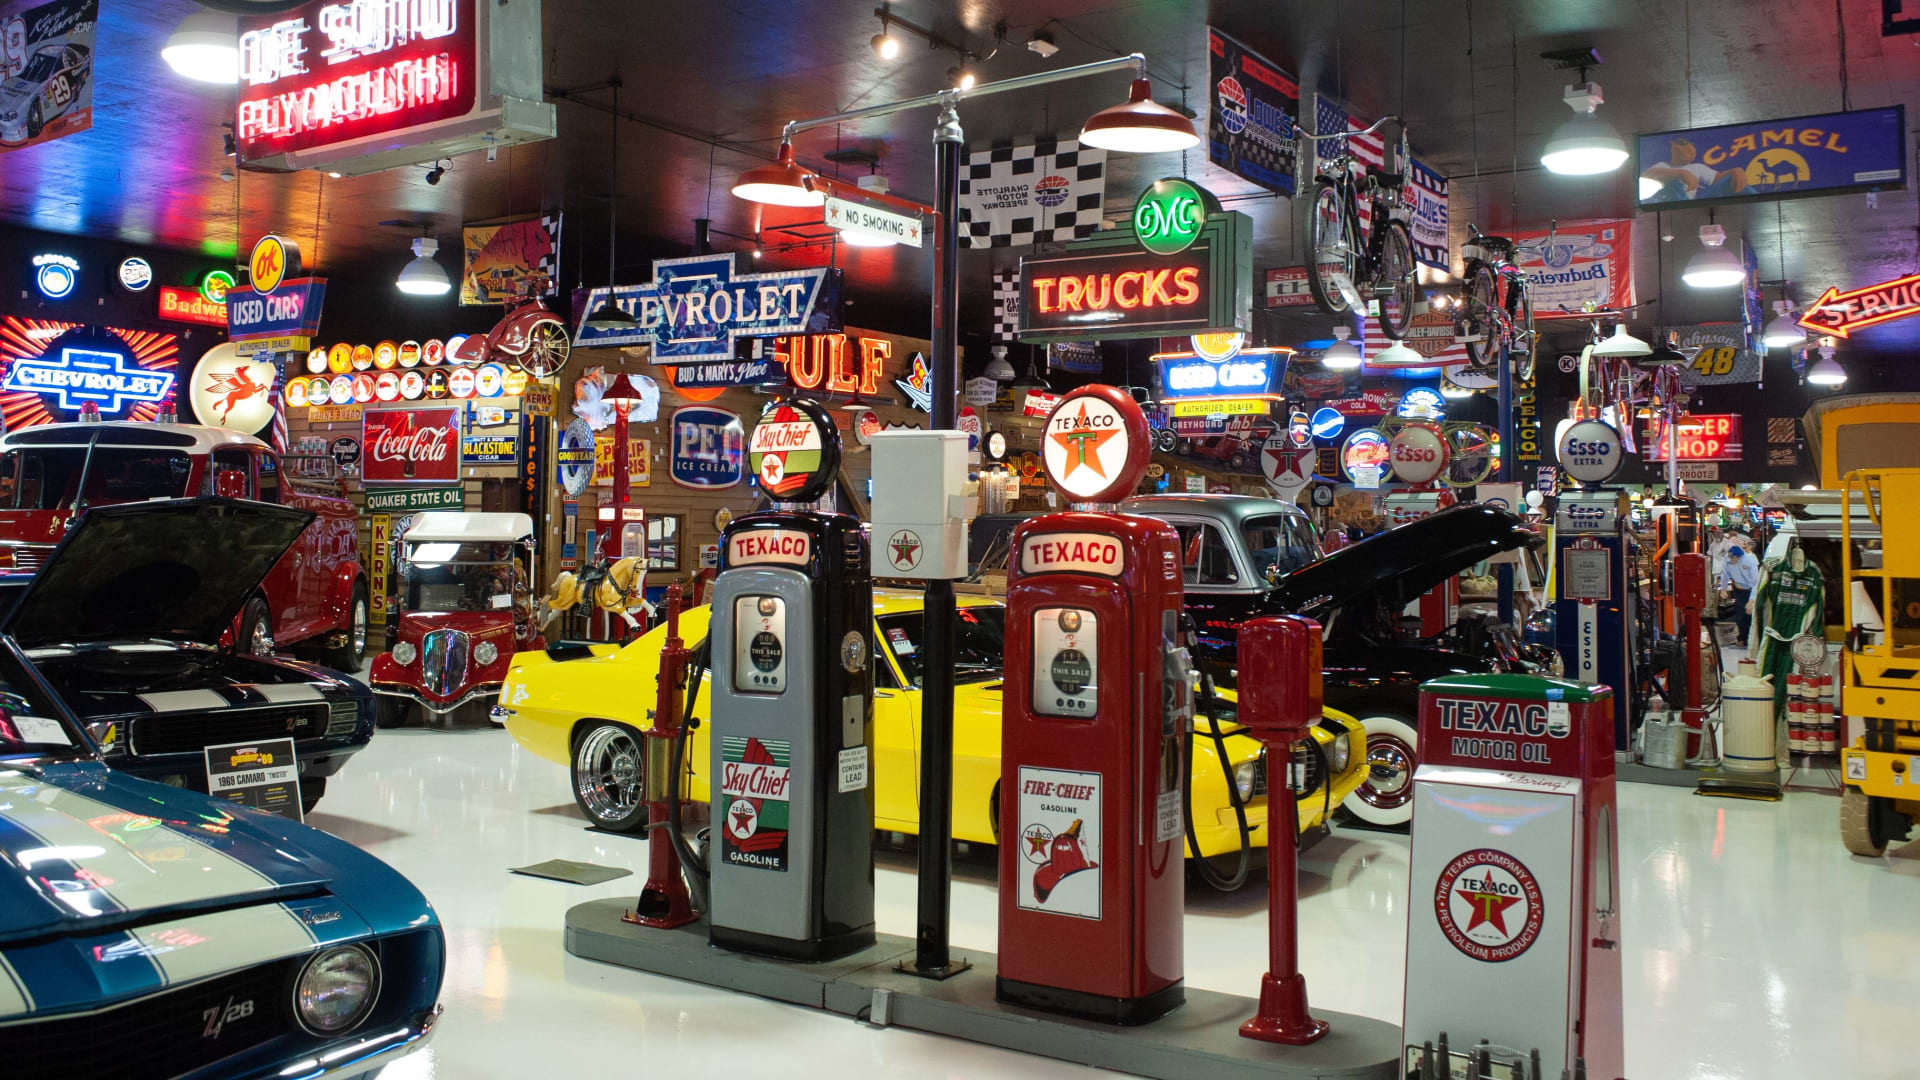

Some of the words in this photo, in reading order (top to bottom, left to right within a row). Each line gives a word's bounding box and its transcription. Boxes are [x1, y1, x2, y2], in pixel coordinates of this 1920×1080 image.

[51, 75, 71, 107] 29
[239, 53, 457, 143] PLYMOUTH
[1703, 127, 1848, 166] CAMEL
[845, 210, 859, 225] NO
[863, 213, 904, 236] SMOKING
[1136, 197, 1195, 238] GMC
[256, 245, 278, 279] OK
[1033, 267, 1200, 313] TRUCKS
[162, 292, 228, 319] Budwe
[233, 297, 263, 326] USED
[266, 293, 300, 323] CARS
[1677, 331, 1738, 348] ohnson
[1694, 346, 1736, 376] 48
[16, 368, 163, 395] CHEVROLET
[678, 366, 695, 383] BUD
[697, 365, 704, 381] &
[704, 364, 735, 379] MARY'S
[735, 361, 768, 383] Place
[1182, 404, 1225, 412] AUTHORIZED
[1228, 403, 1254, 411] DEALER
[1055, 415, 1114, 430] TEXACO
[1173, 420, 1223, 429] GREYHOUND
[677, 421, 739, 462] PET
[756, 424, 777, 449] Sky
[776, 422, 811, 447] Chief
[463, 441, 515, 455] BLACKSTONE
[558, 451, 594, 460] GOODYEAR
[1661, 440, 1719, 457] SHOP
[677, 461, 694, 471] ICE
[699, 462, 737, 473] CREAM
[1574, 458, 1603, 466] EXTRA
[367, 494, 407, 508] QUAKER
[410, 492, 440, 506] STATE
[443, 490, 461, 503] OIL
[701, 552, 717, 560] PEP
[736, 536, 806, 558] TEXACO
[1030, 541, 1117, 565] TEXACO
[373, 525, 385, 609] KERN'S
[766, 648, 780, 656] SALE
[1072, 668, 1090, 676] SALE
[1452, 736, 1516, 761] MOTOR
[1521, 742, 1551, 764] OIL
[841, 762, 865, 773] CONTAINS
[845, 771, 862, 783] LEAD
[218, 776, 235, 787] 1969
[237, 772, 266, 785] CAMARO
[722, 762, 750, 797] Sky
[749, 765, 790, 796] Chief
[1023, 780, 1096, 800] FIRE-CHIEF
[732, 806, 754, 814] TEXACO
[1040, 804, 1078, 814] GASOLINE
[1026, 830, 1052, 839] TEXACO
[730, 851, 780, 867] GASOLINE
[1438, 879, 1450, 900] THE
[1446, 854, 1476, 878] TEXAS
[1478, 852, 1528, 879] COMPANY
[1461, 878, 1519, 896] TEXACO
[1439, 909, 1488, 959] PETROLEUM
[1491, 920, 1538, 958] PRODUCTS
[203, 996, 254, 1040] Z/28
